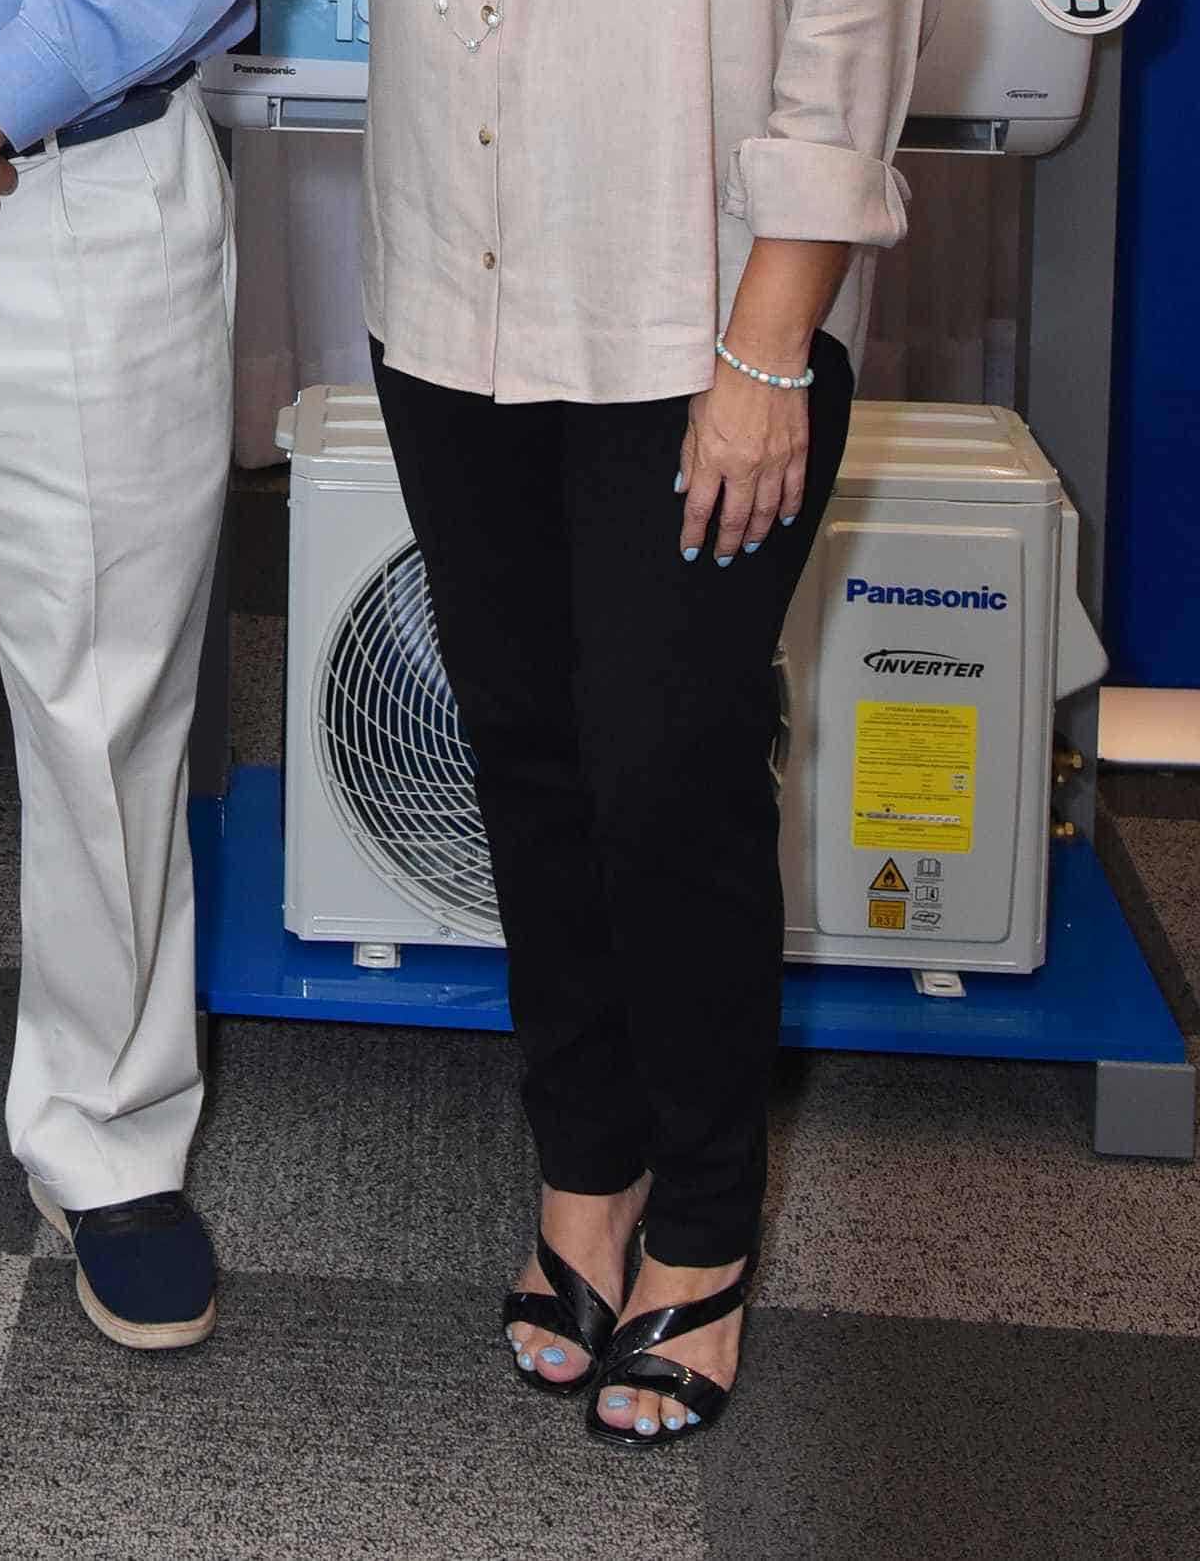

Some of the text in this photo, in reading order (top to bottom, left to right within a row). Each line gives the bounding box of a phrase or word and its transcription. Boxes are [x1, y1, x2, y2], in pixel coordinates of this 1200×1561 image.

[232, 62, 296, 76] Panasonic
[845, 577, 1008, 611] Panasonic
[875, 649, 985, 679] INVERTER
